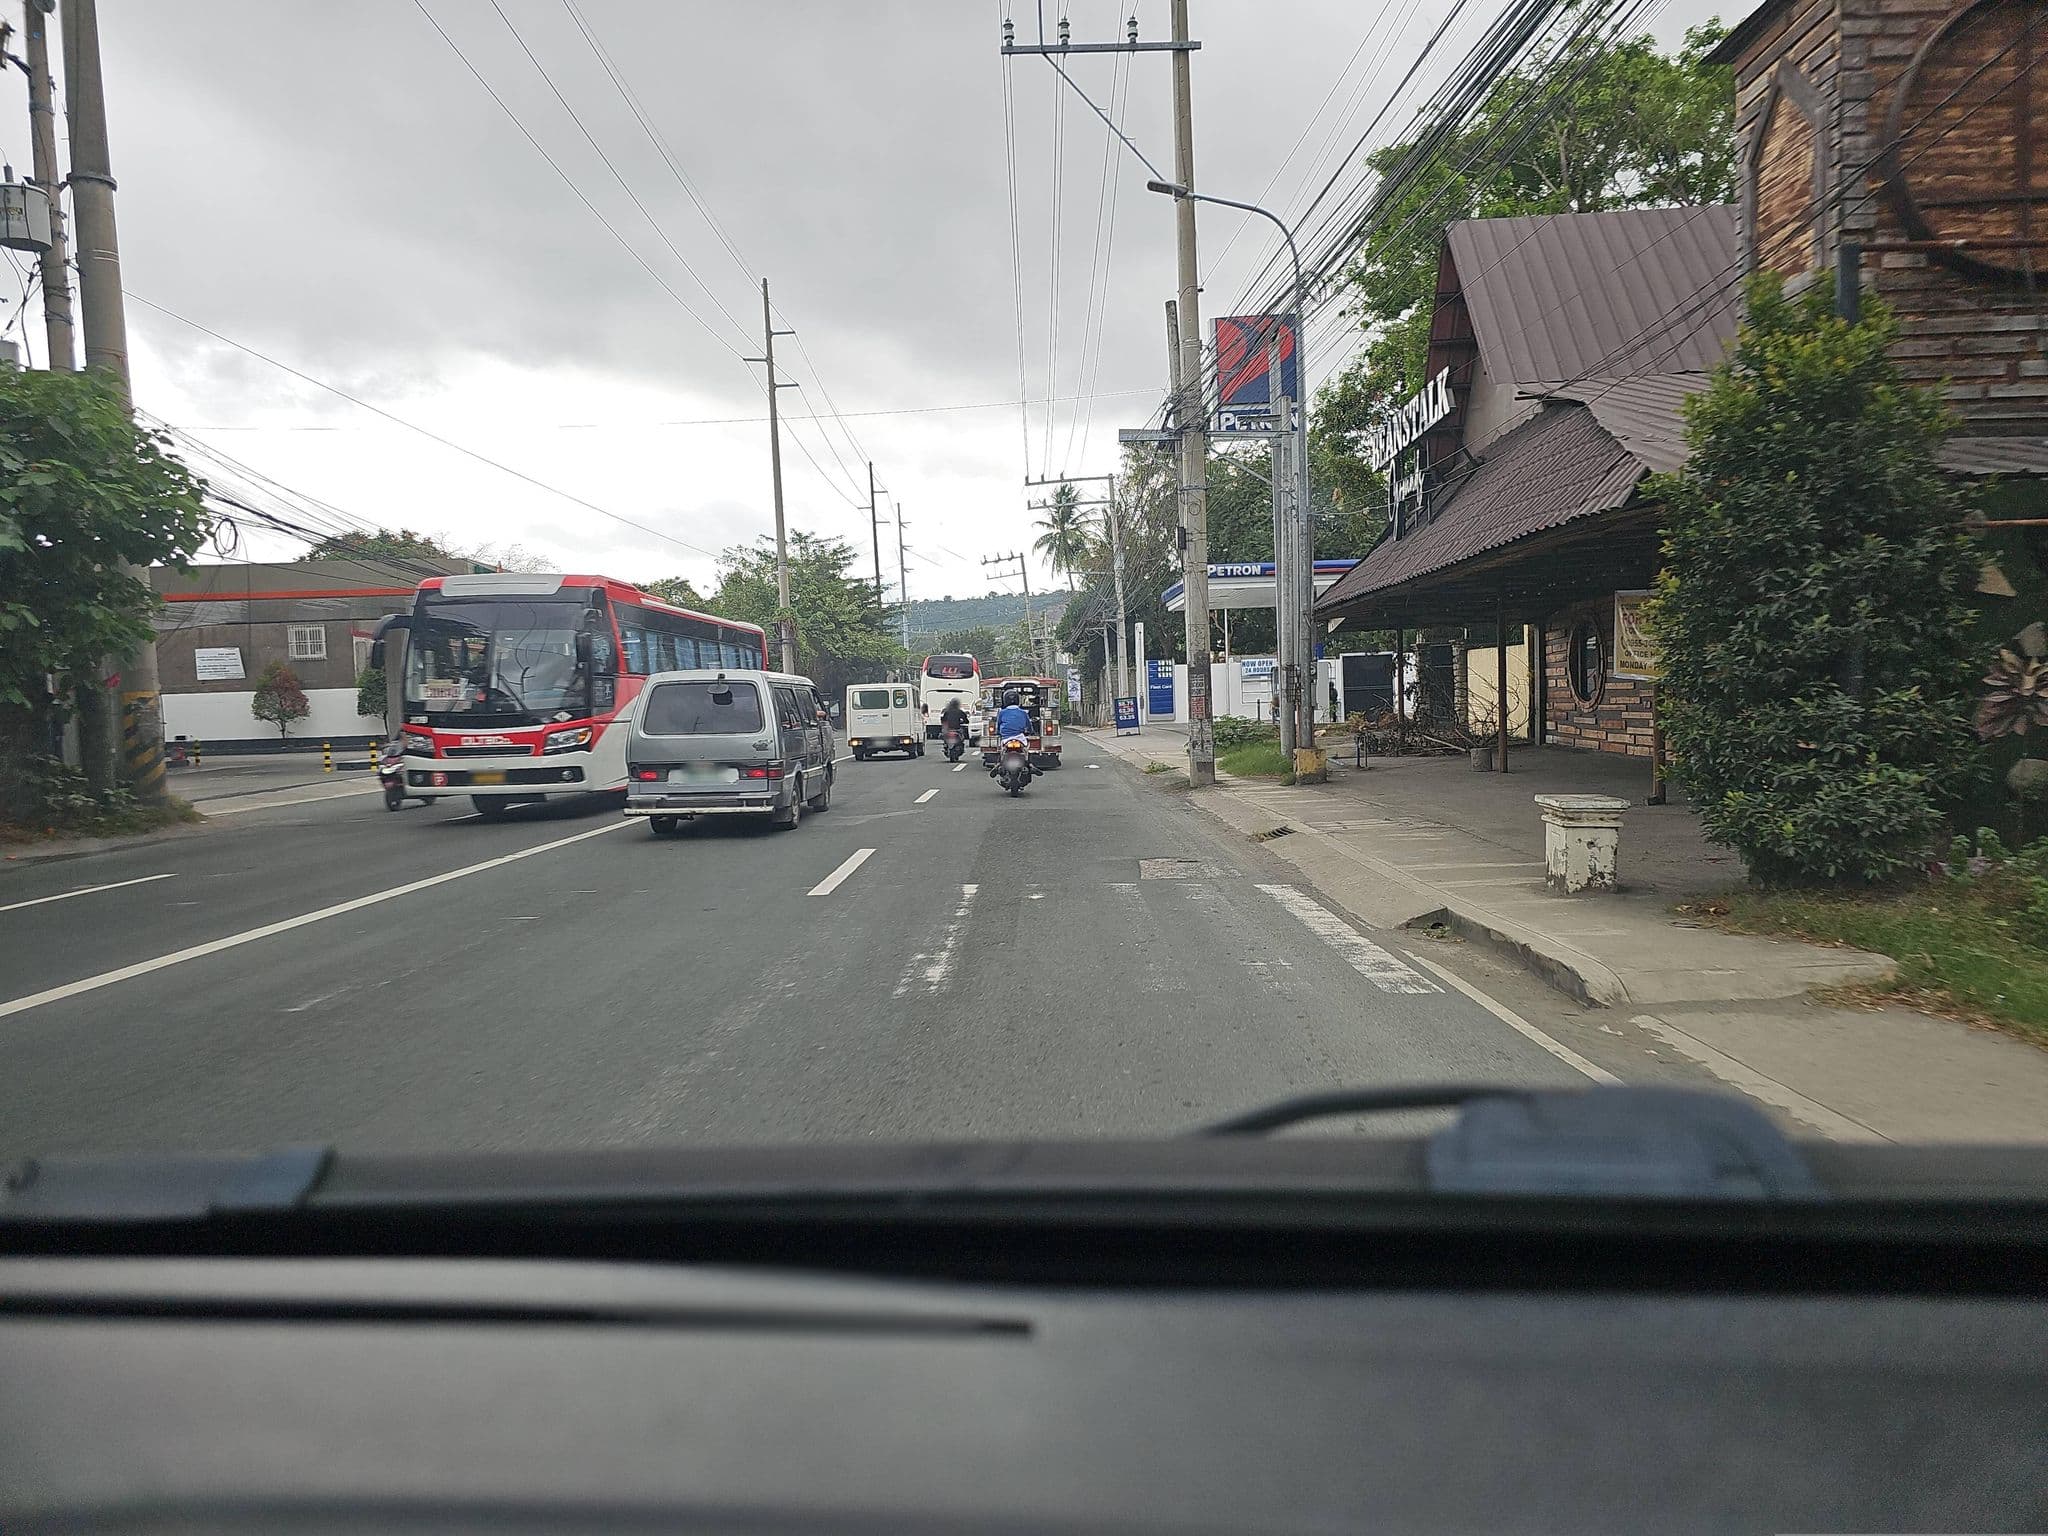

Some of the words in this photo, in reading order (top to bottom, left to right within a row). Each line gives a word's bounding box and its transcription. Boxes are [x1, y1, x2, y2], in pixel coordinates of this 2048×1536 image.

[1220, 412, 1299, 431] PEN
[1372, 366, 1450, 473] BEANSTALK
[1207, 564, 1261, 577] PETRON
[1242, 660, 1257, 668] NOW
[1619, 660, 1648, 670] MONDAY
